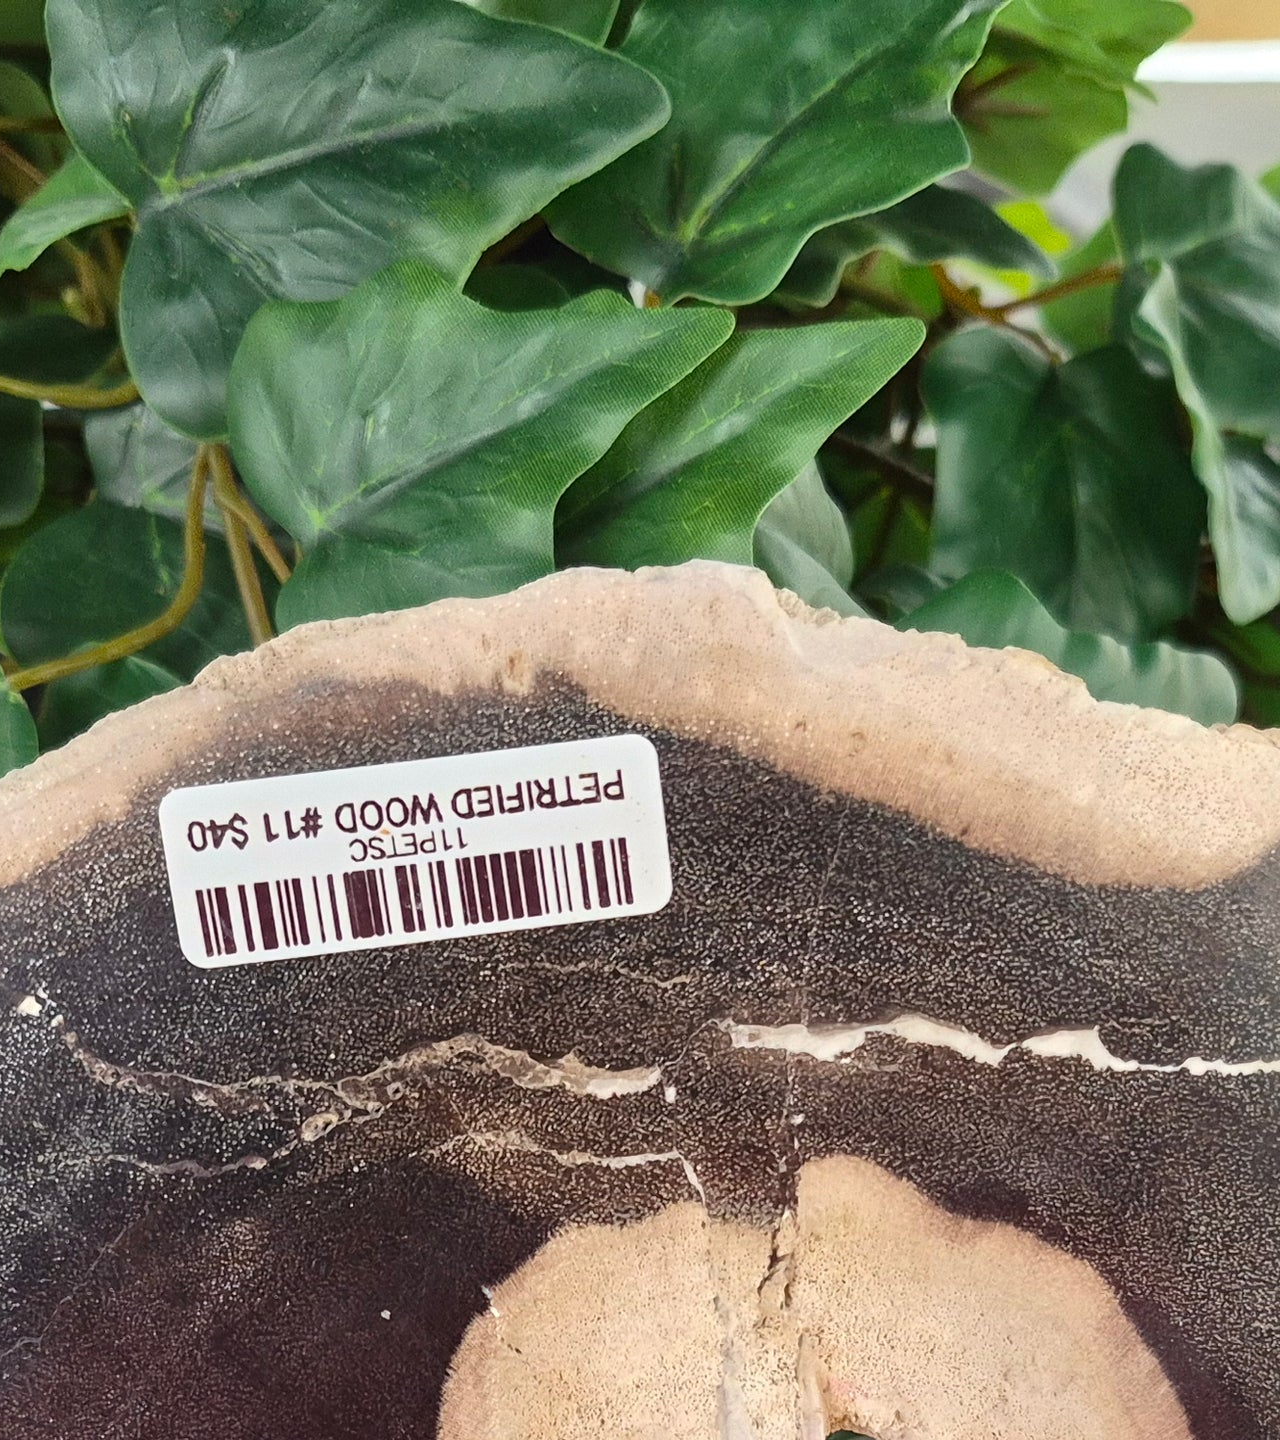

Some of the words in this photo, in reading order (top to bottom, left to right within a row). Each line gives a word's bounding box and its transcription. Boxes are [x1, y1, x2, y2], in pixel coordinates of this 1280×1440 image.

[335, 794, 443, 834] WOOD
[451, 769, 625, 820] PETRIFIED
[187, 812, 249, 852] $40
[262, 806, 323, 843] #11
[349, 826, 468, 862] 11PETSC
